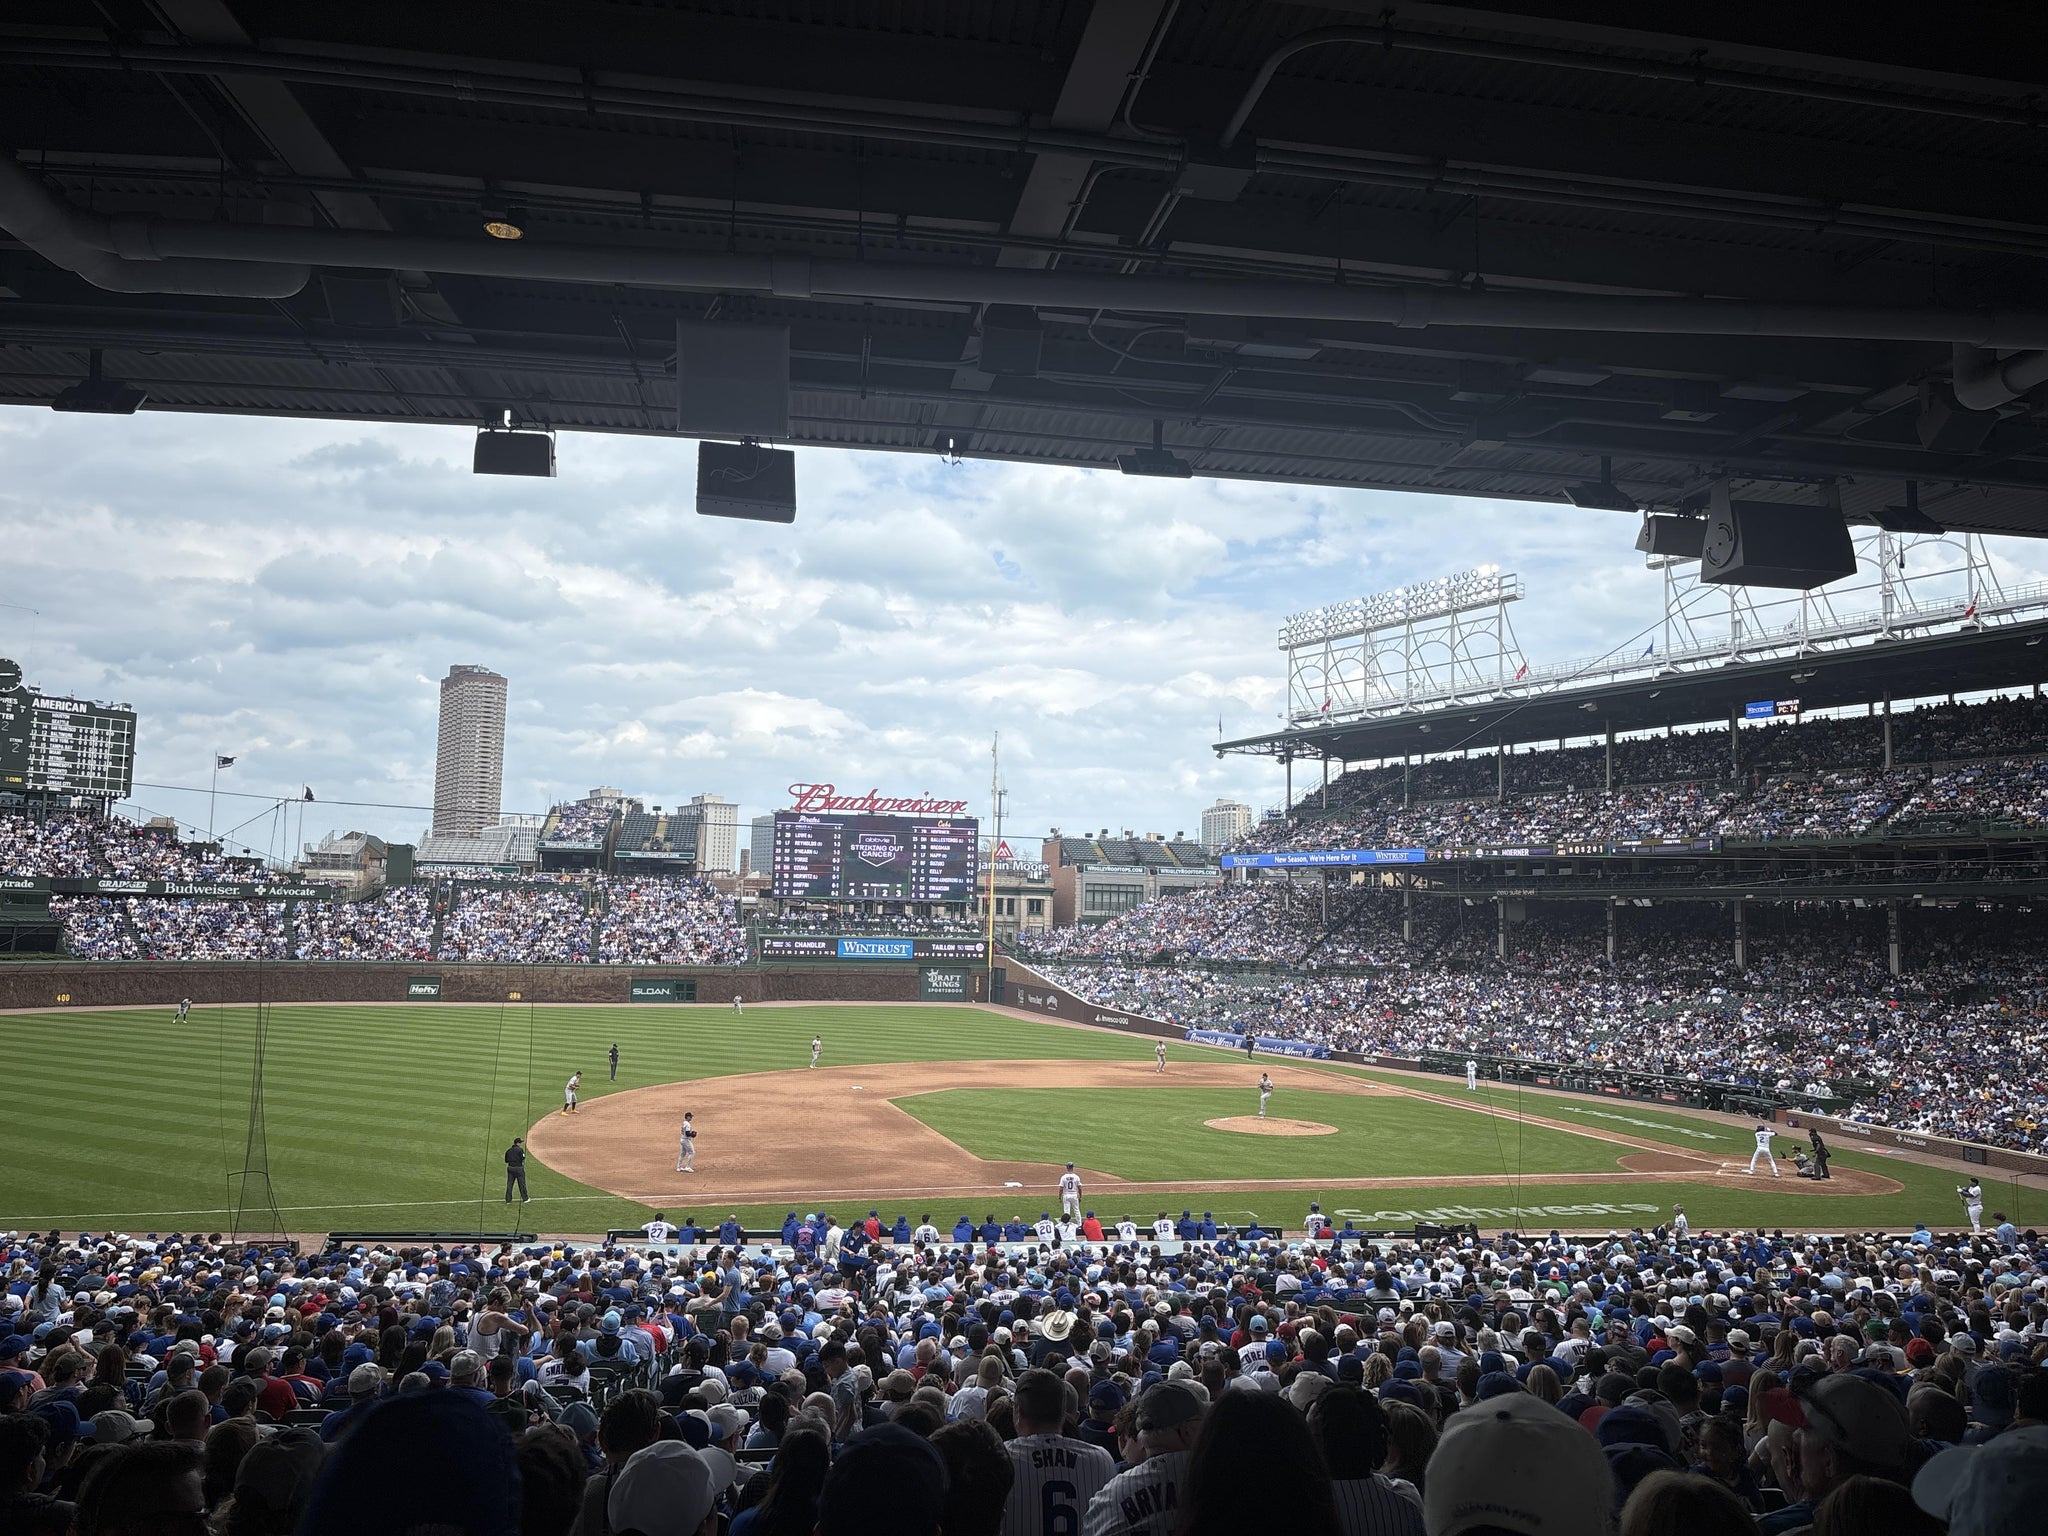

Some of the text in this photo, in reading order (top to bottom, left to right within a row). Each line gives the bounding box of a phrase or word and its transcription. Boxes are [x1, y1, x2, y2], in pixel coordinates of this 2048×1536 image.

[32, 698, 87, 713] AMERICAN
[1, 721, 9, 731] 2
[12, 743, 19, 753] 2
[788, 783, 968, 813] Budweiser
[799, 815, 820, 823] Pirates
[850, 844, 887, 852] STRIKING
[1288, 855, 1308, 864] Season,
[1309, 854, 1324, 862] We're
[1325, 854, 1339, 862] Here
[1375, 852, 1409, 860] WINTRUST
[1012, 861, 1049, 872] Moore
[269, 886, 315, 896] Advocate
[848, 888, 855, 896] 4
[882, 889, 888, 897] 2
[896, 889, 902, 898] 3
[794, 941, 826, 949] CHANDLER
[842, 941, 910, 954] WINTRUST
[928, 974, 962, 983] DRAFT
[411, 985, 437, 994] Hefty
[57, 994, 71, 1002] 400
[1101, 1014, 1119, 1023] Invesco
[1190, 1033, 1216, 1045] Reynolds
[1253, 1042, 1283, 1053] Reynolds
[1839, 1123, 1871, 1135] TimberTech
[1903, 1136, 1927, 1146] Advocate
[1067, 1181, 1073, 1190] 0
[1334, 1203, 1633, 1223] Southwest
[1039, 1225, 1052, 1235] 20
[1064, 1224, 1069, 1233] 7
[1126, 1227, 1132, 1236] 4
[1158, 1223, 1170, 1233] 15
[1314, 1222, 1321, 1231] 3
[650, 1228, 664, 1239] 27
[924, 1233, 931, 1242] 6
[1031, 1449, 1079, 1470] SHAW
[1041, 1480, 1079, 1536] 6
